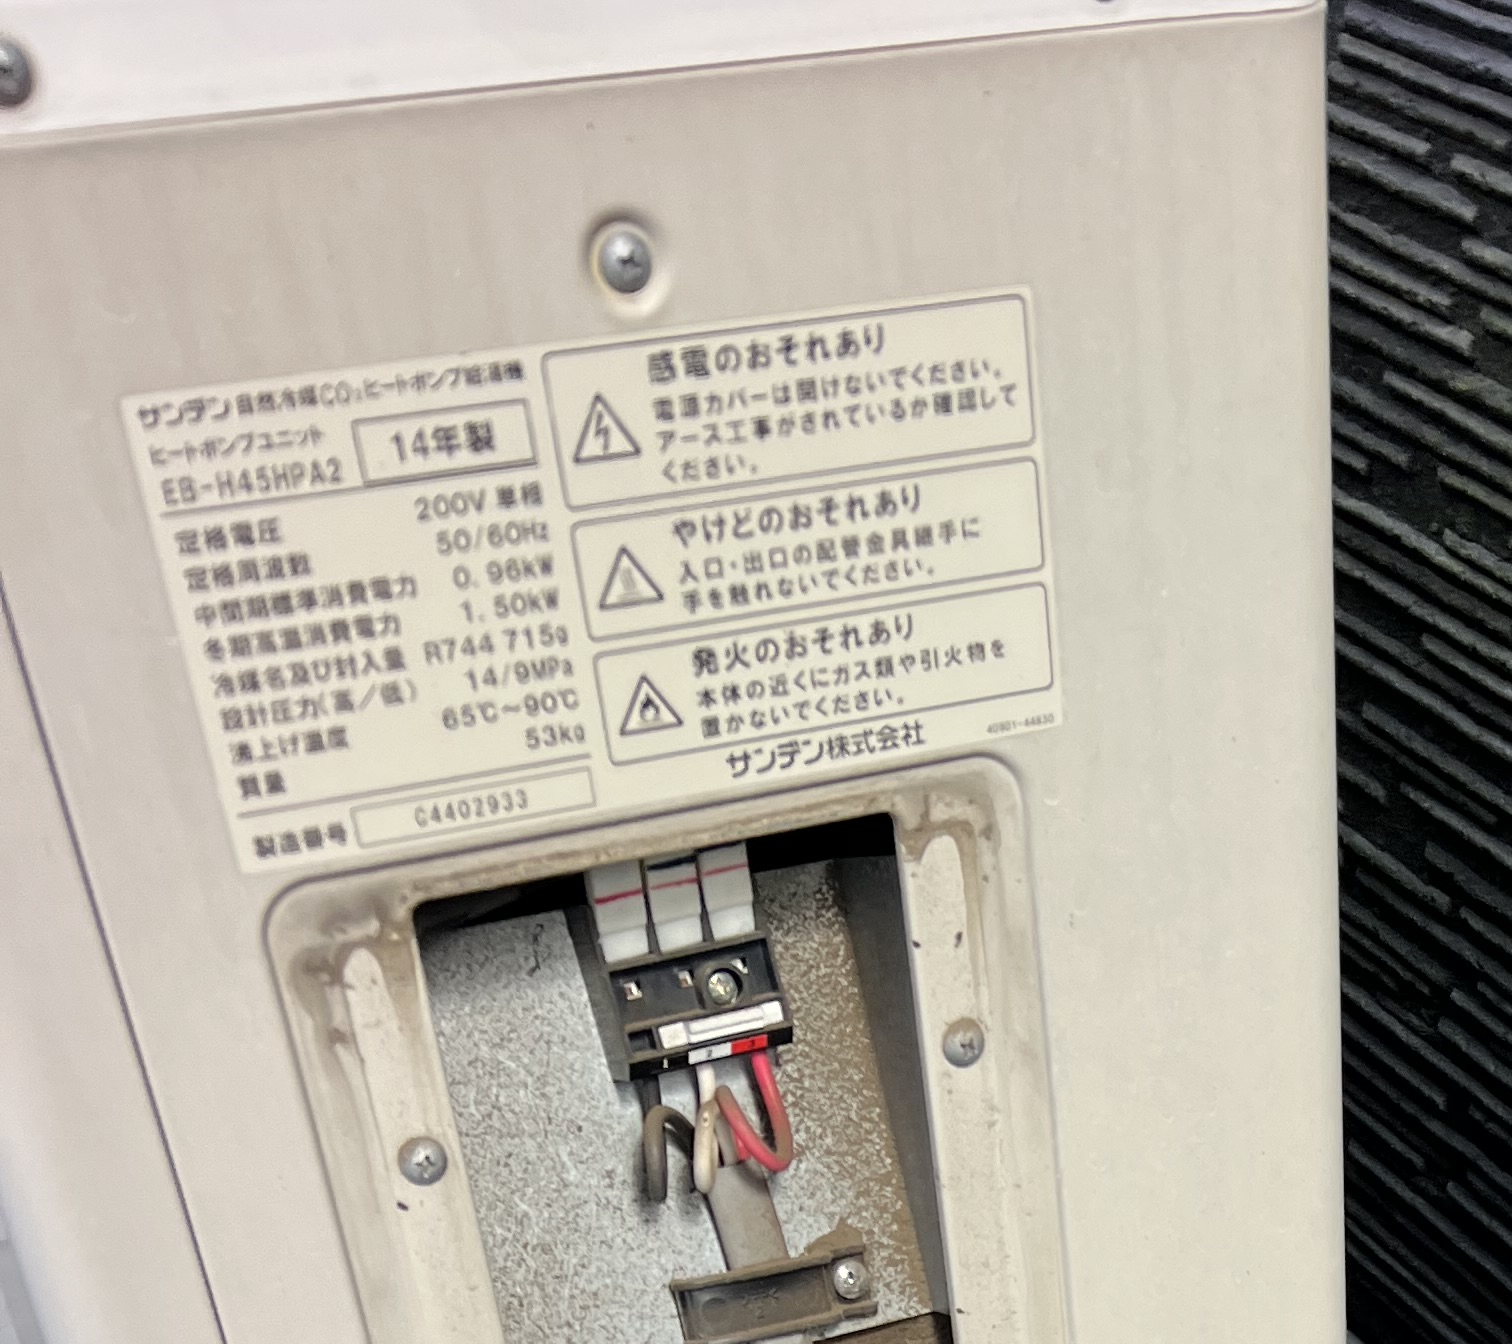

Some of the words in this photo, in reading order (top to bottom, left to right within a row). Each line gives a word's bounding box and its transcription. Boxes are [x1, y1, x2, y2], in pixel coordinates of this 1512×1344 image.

[647, 321, 888, 386] 感電のおそれあり
[390, 418, 496, 464] 14年製
[661, 453, 760, 484] ください。
[414, 488, 487, 522] 200V
[671, 483, 924, 549] やけどのおそれあり
[436, 520, 550, 556] 50/60Hz
[681, 557, 936, 615] 手を触れないでください。
[422, 632, 495, 666] R744
[691, 612, 915, 679] 発火のおそれあり
[696, 638, 1007, 710] 本体の近くにガス類や引火物を
[525, 723, 587, 751] 53kg
[700, 687, 905, 739] 置かないでください。
[725, 719, 927, 779] サンデン株式会社
